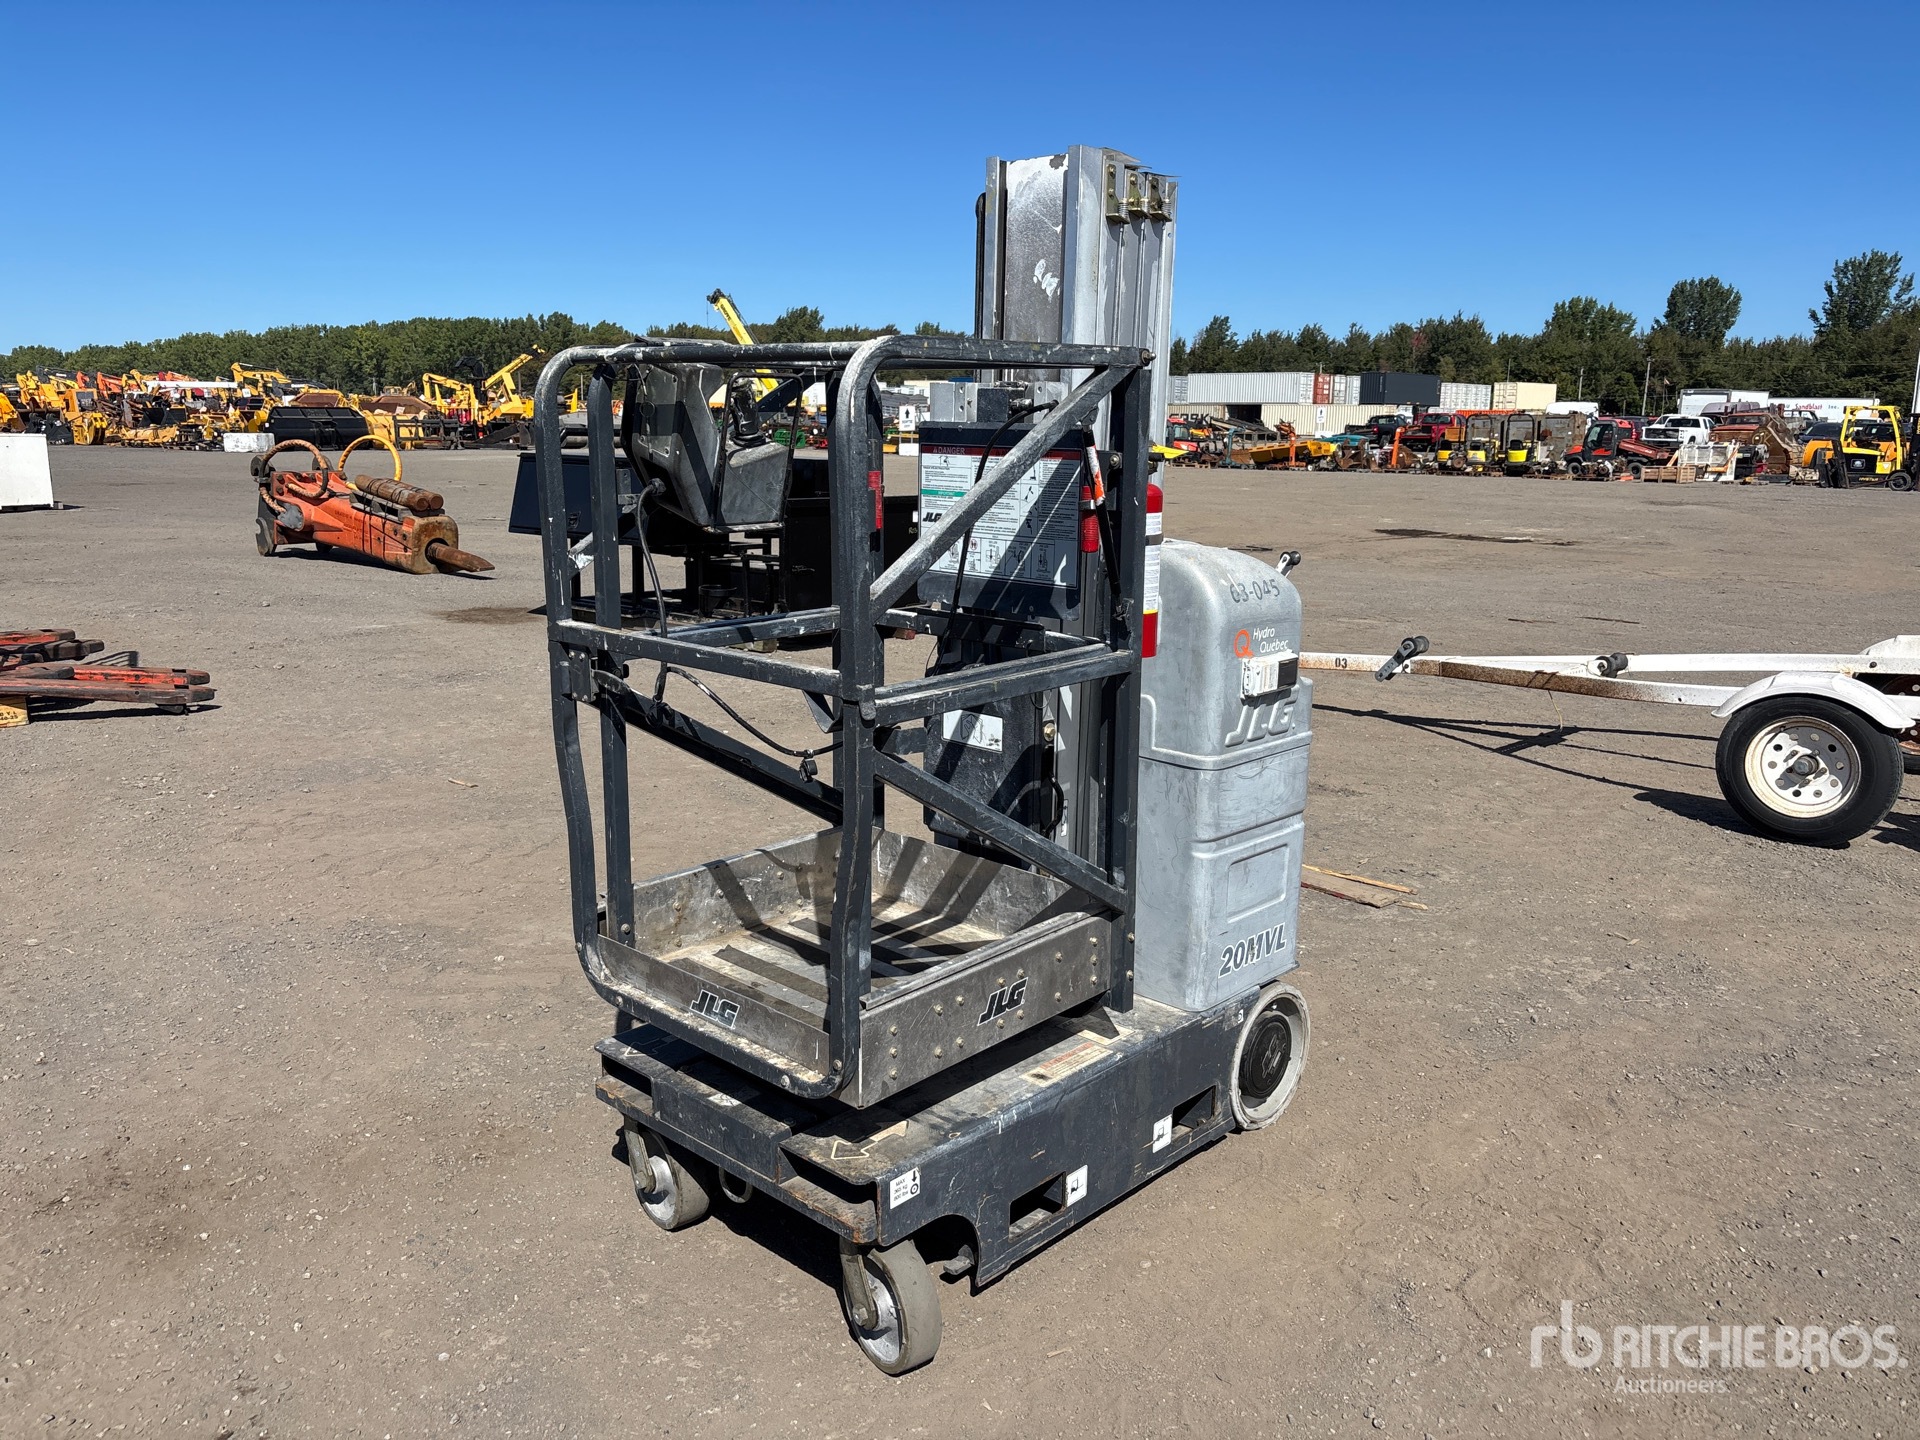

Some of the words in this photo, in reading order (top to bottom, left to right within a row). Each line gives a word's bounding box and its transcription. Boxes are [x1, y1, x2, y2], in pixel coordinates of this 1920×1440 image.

[939, 446, 965, 455] DANGER
[1230, 578, 1280, 604] 63-045
[1252, 626, 1275, 642] Hydro
[1260, 638, 1288, 654] Québec
[1335, 657, 1347, 669] 03
[1217, 922, 1287, 979] 20MVL
[690, 989, 741, 1030] JLG
[977, 976, 1029, 1027] JLG
[896, 1178, 905, 1186] MAX
